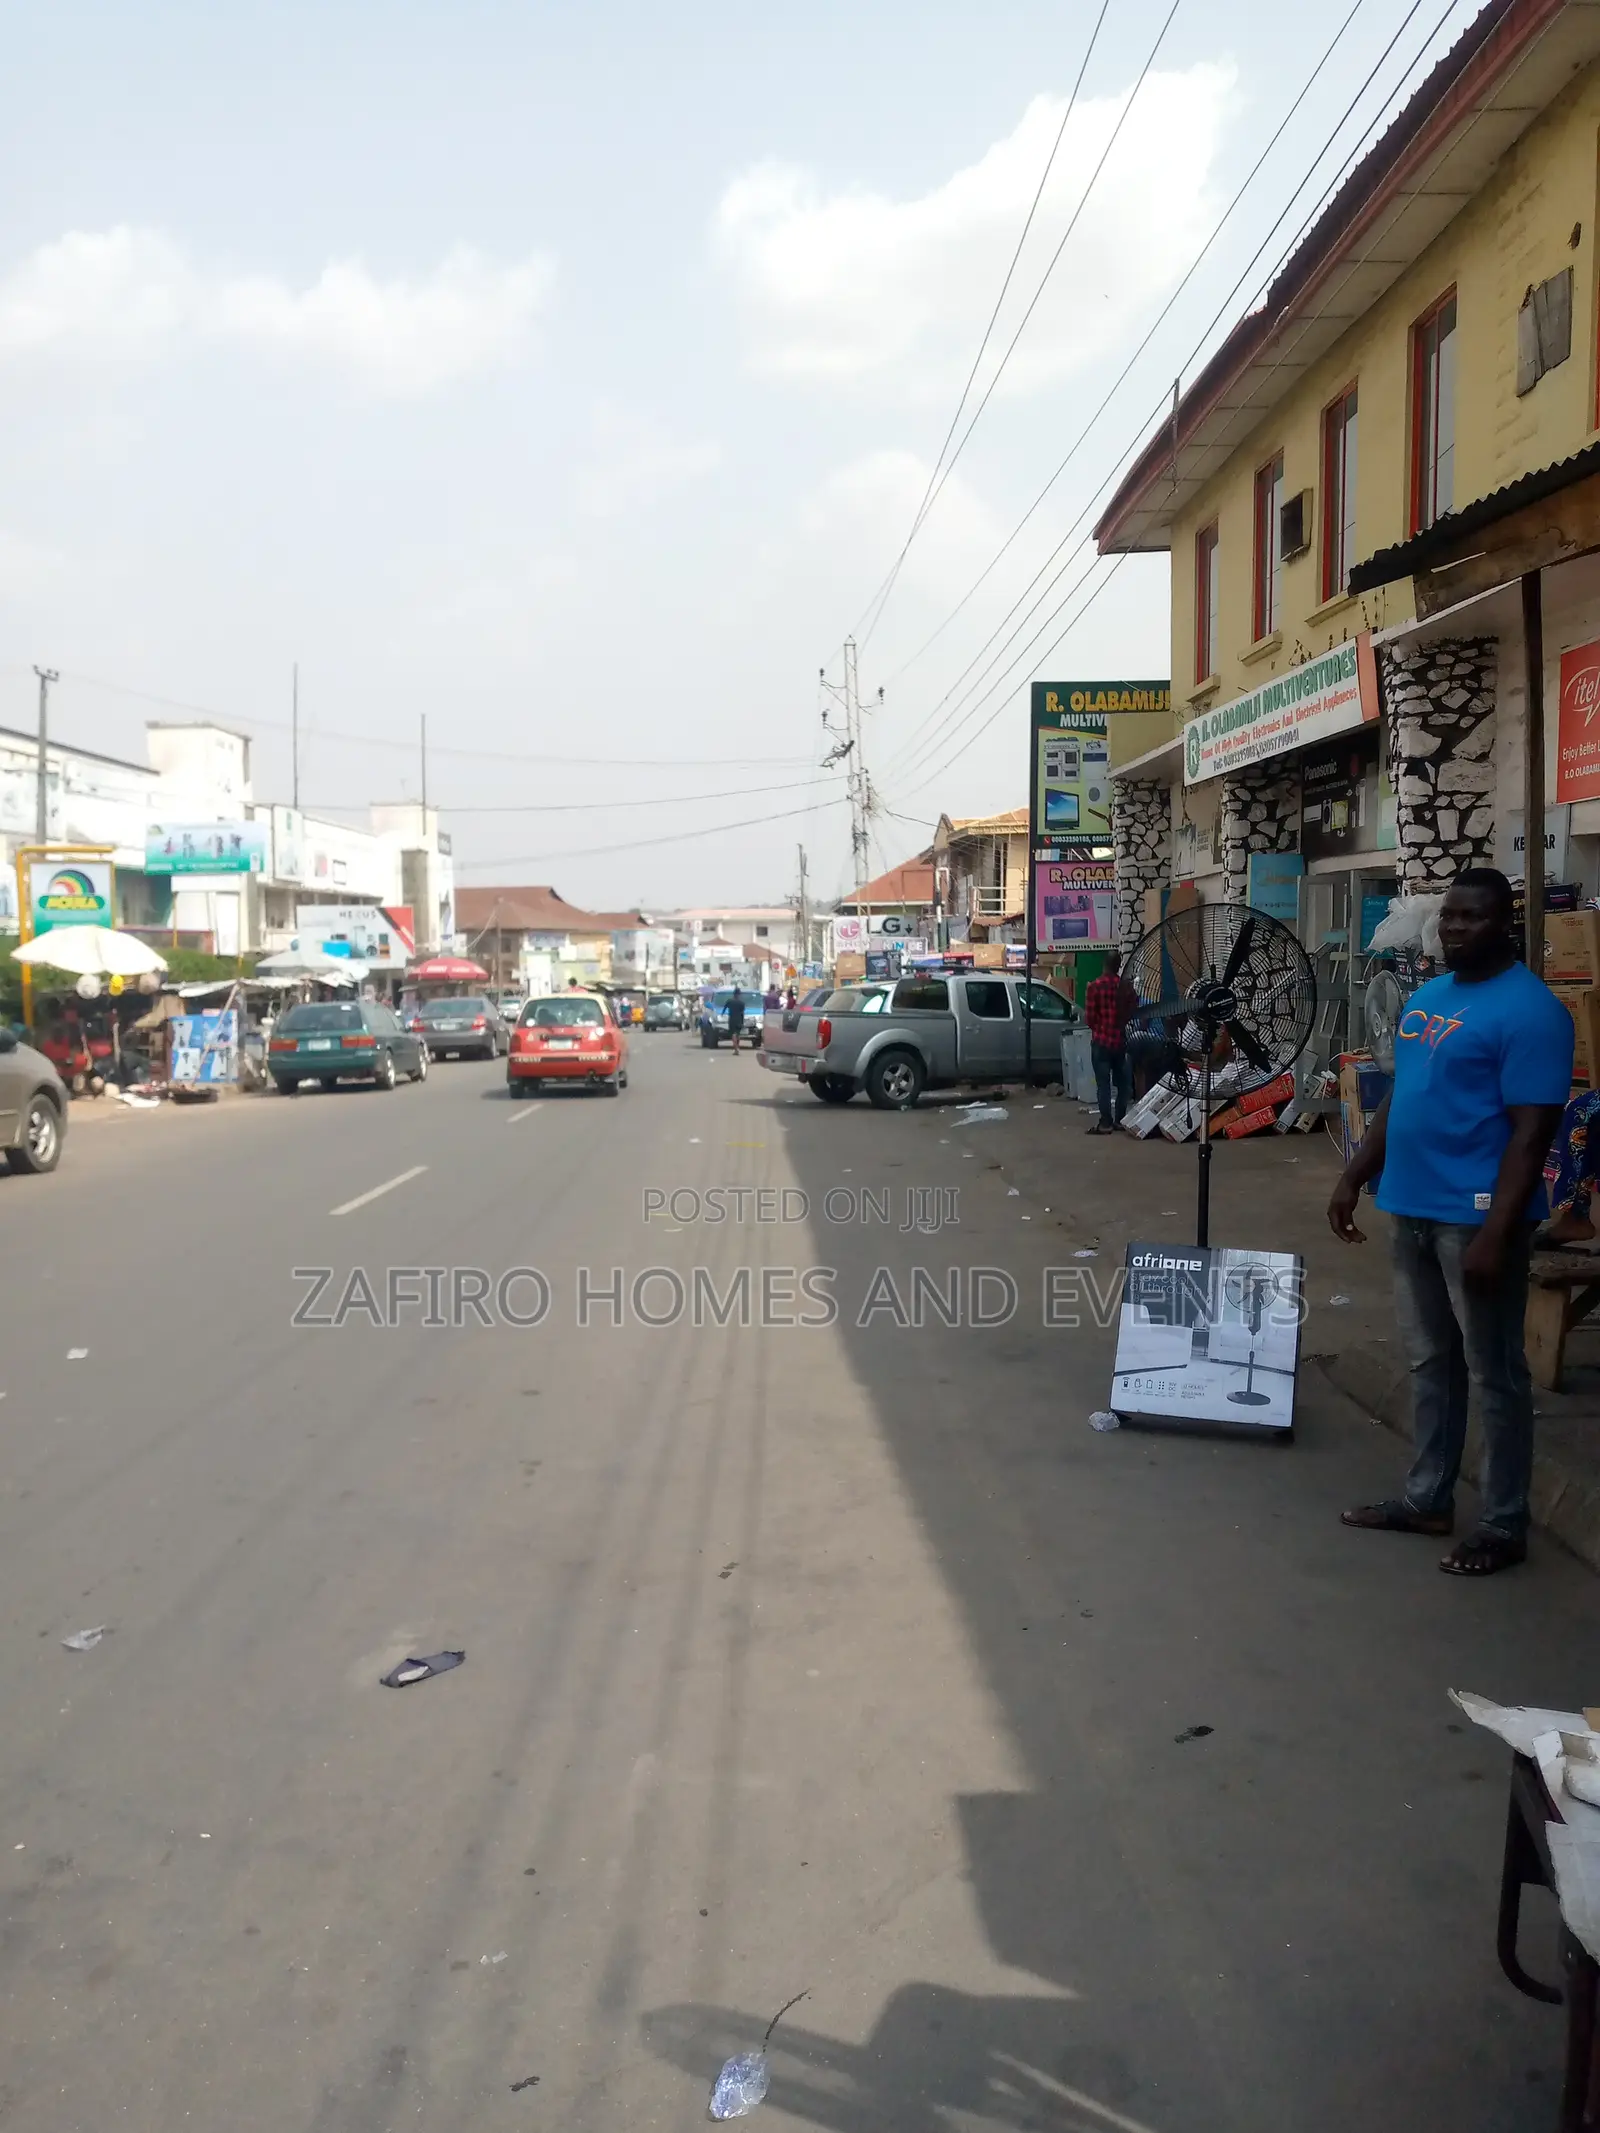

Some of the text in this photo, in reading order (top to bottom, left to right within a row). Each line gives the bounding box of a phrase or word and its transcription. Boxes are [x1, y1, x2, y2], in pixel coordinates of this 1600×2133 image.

[1263, 645, 1357, 716] MULTIVENTURES
[1574, 668, 1600, 705] itel
[1046, 691, 1065, 712] R.
[1252, 719, 1281, 740] Electronics
[1282, 710, 1294, 729] And
[1295, 697, 1322, 722] Electrical
[1323, 688, 1357, 713] Appliances
[1562, 746, 1579, 763] Enjoy
[1579, 741, 1597, 757] Better
[1304, 759, 1338, 783] Panasonic
[1513, 833, 1556, 852] KEAR
[1049, 867, 1067, 884] R.
[1400, 1005, 1466, 1060] CR7
